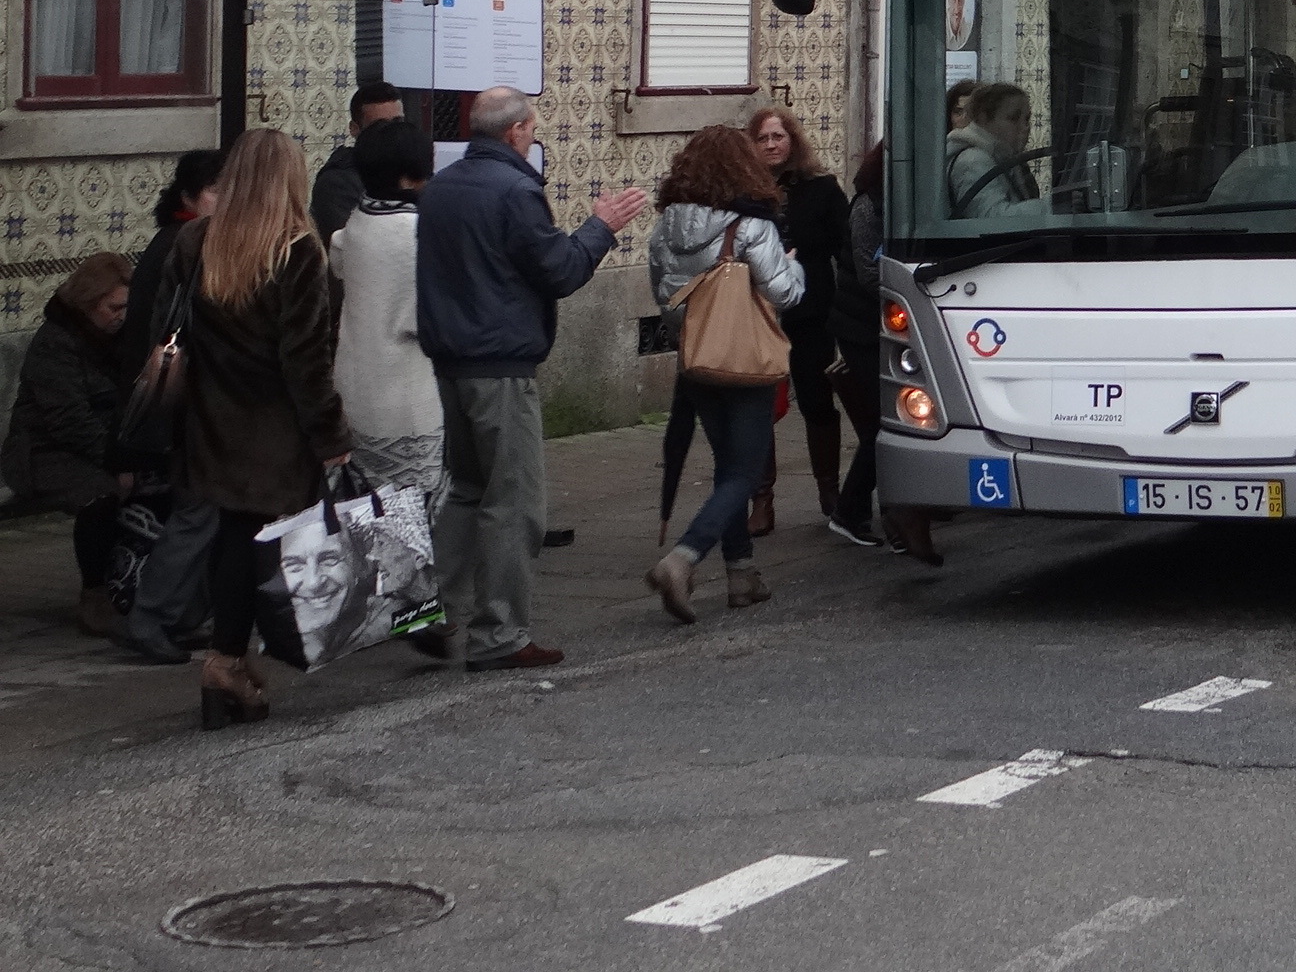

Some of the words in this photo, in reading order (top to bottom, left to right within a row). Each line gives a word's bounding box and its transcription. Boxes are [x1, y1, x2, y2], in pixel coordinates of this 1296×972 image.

[1088, 384, 1123, 408] TP
[1054, 413, 1078, 422] Alvará
[1089, 414, 1122, 422] 432/2012
[1268, 485, 1281, 495] 10
[1269, 503, 1281, 512] 02
